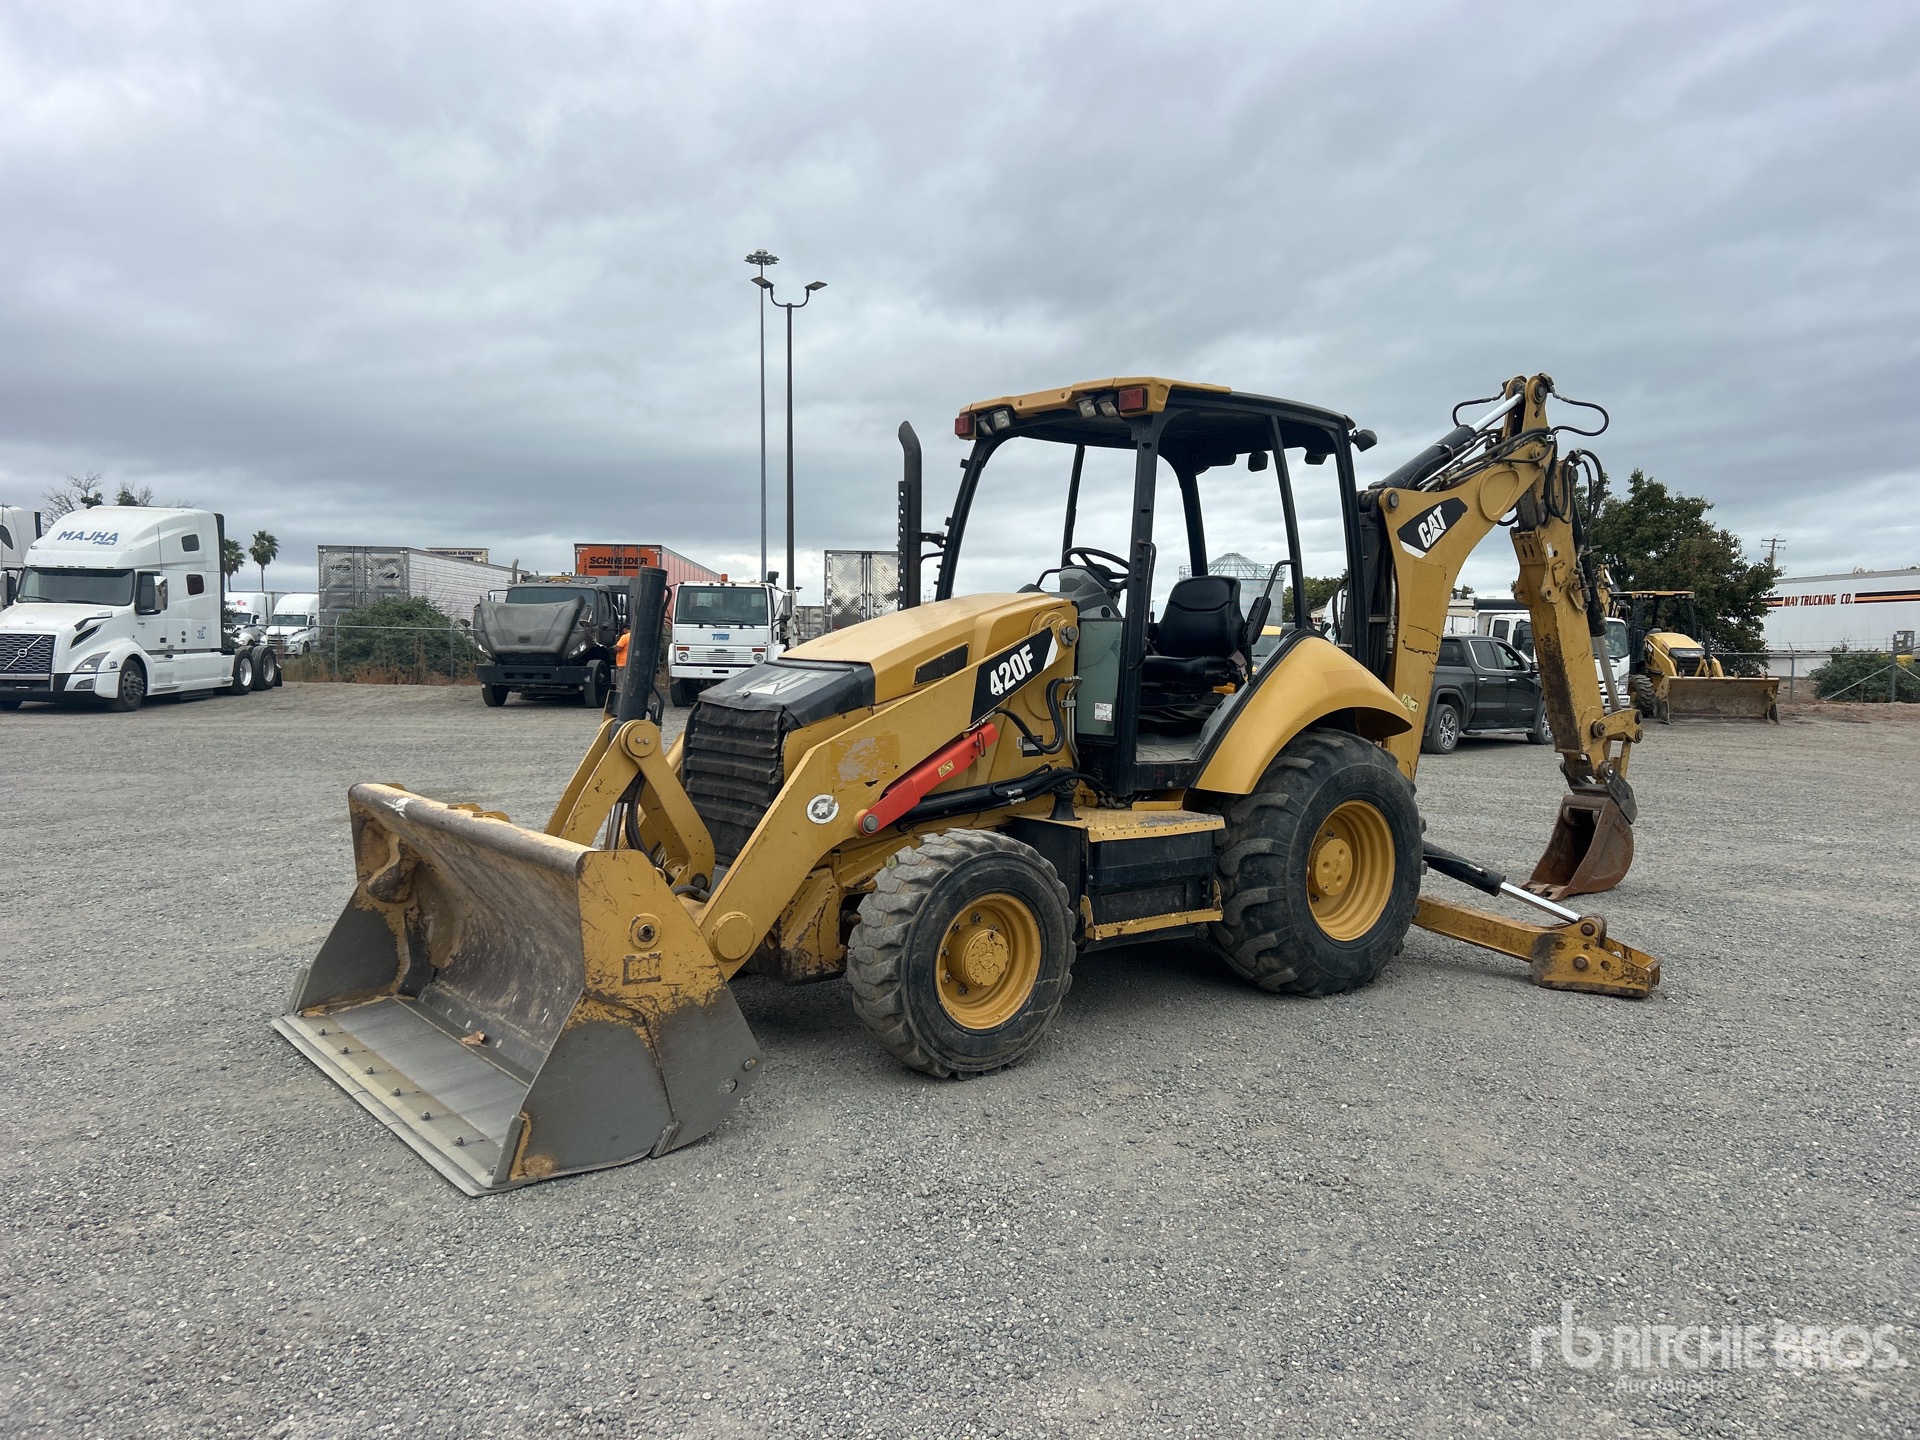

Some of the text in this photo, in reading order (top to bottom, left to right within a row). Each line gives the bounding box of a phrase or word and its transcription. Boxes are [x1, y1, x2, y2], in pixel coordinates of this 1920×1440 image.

[1418, 504, 1447, 549] CAT
[57, 530, 119, 542] MAJHA
[589, 556, 648, 565] SCHNEIDER
[1783, 593, 1853, 607] MAY TRUCKING CO.
[990, 643, 1034, 696] 420F
